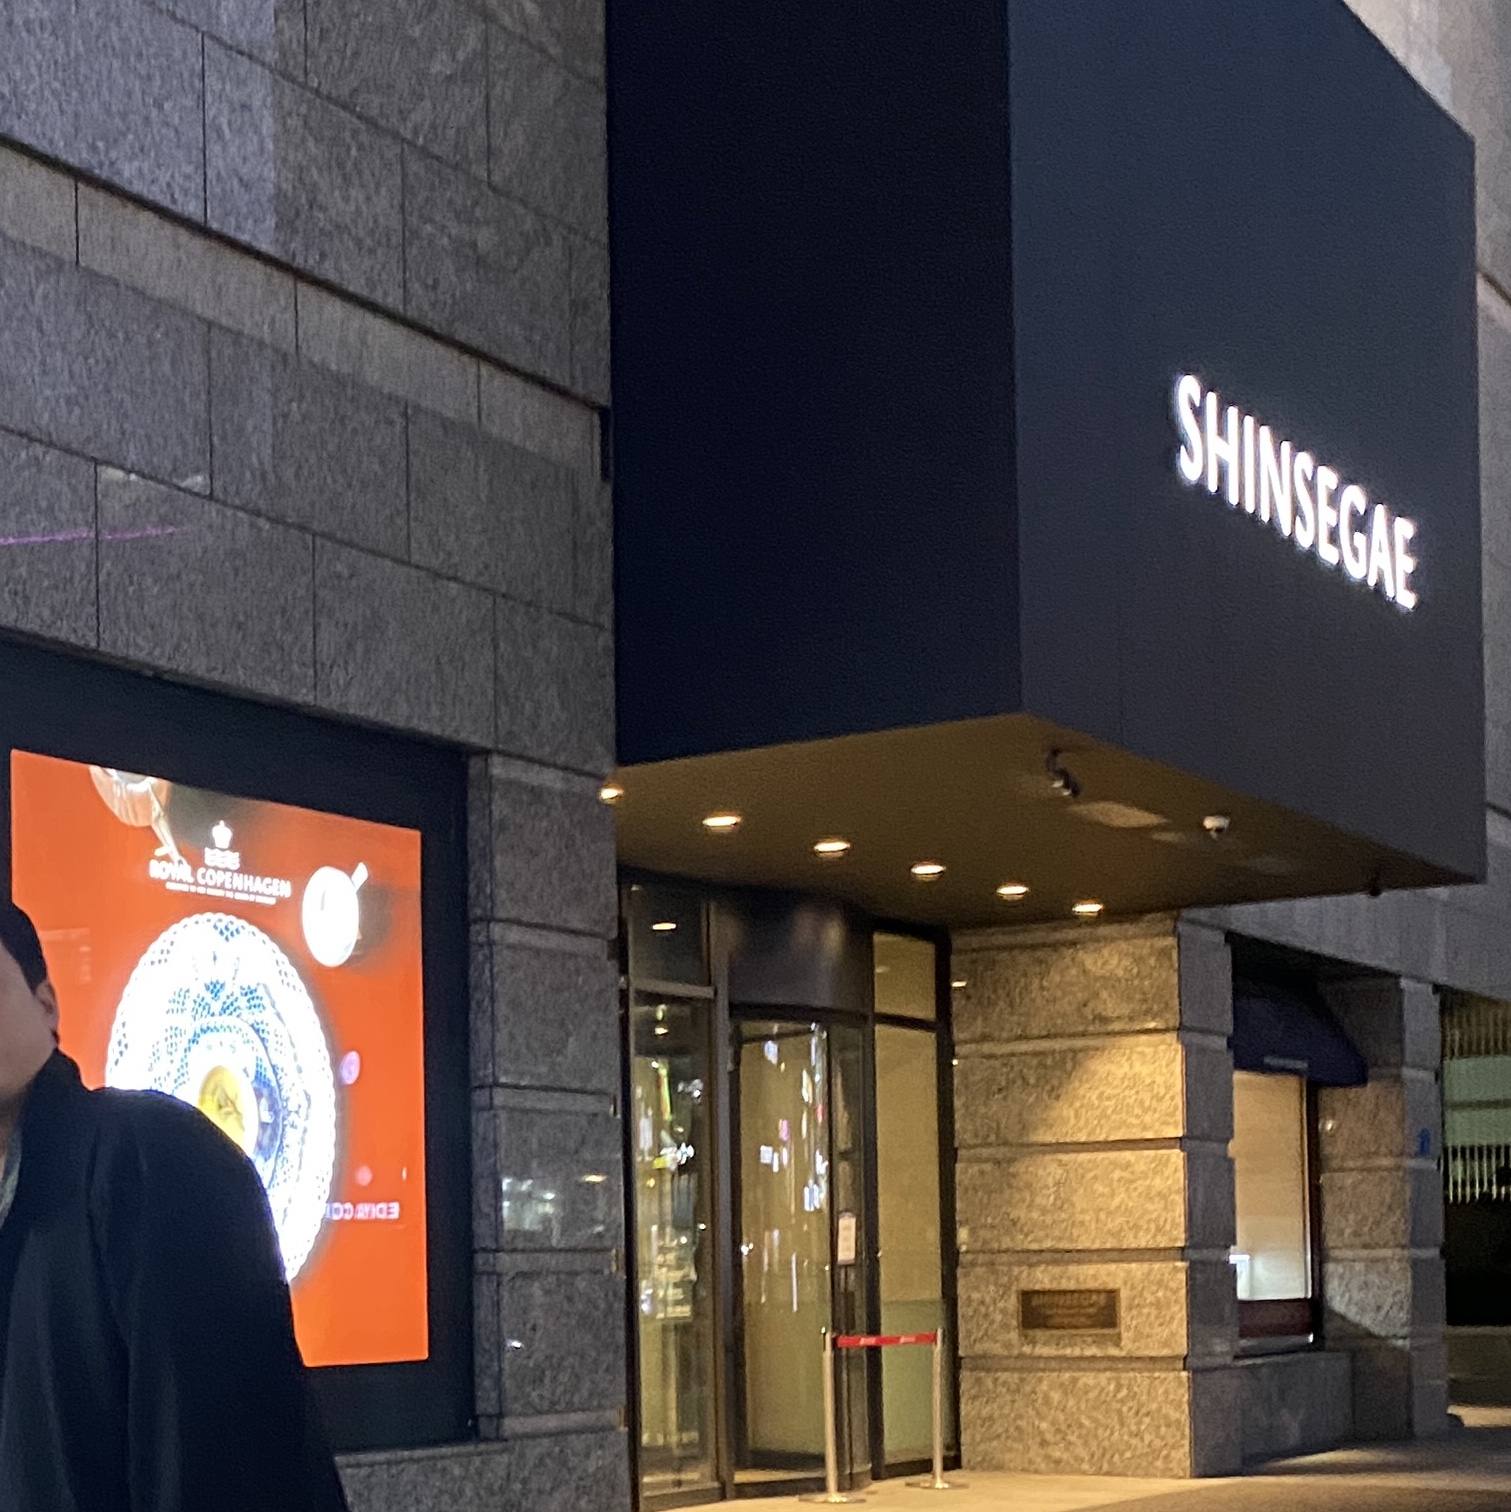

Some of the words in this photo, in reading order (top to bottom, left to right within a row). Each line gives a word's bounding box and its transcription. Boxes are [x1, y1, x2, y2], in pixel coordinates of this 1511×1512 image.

[1176, 373, 1418, 610] SHINSEGAE
[149, 858, 194, 883] ROYAL
[196, 867, 293, 899] COPENHAGEN
